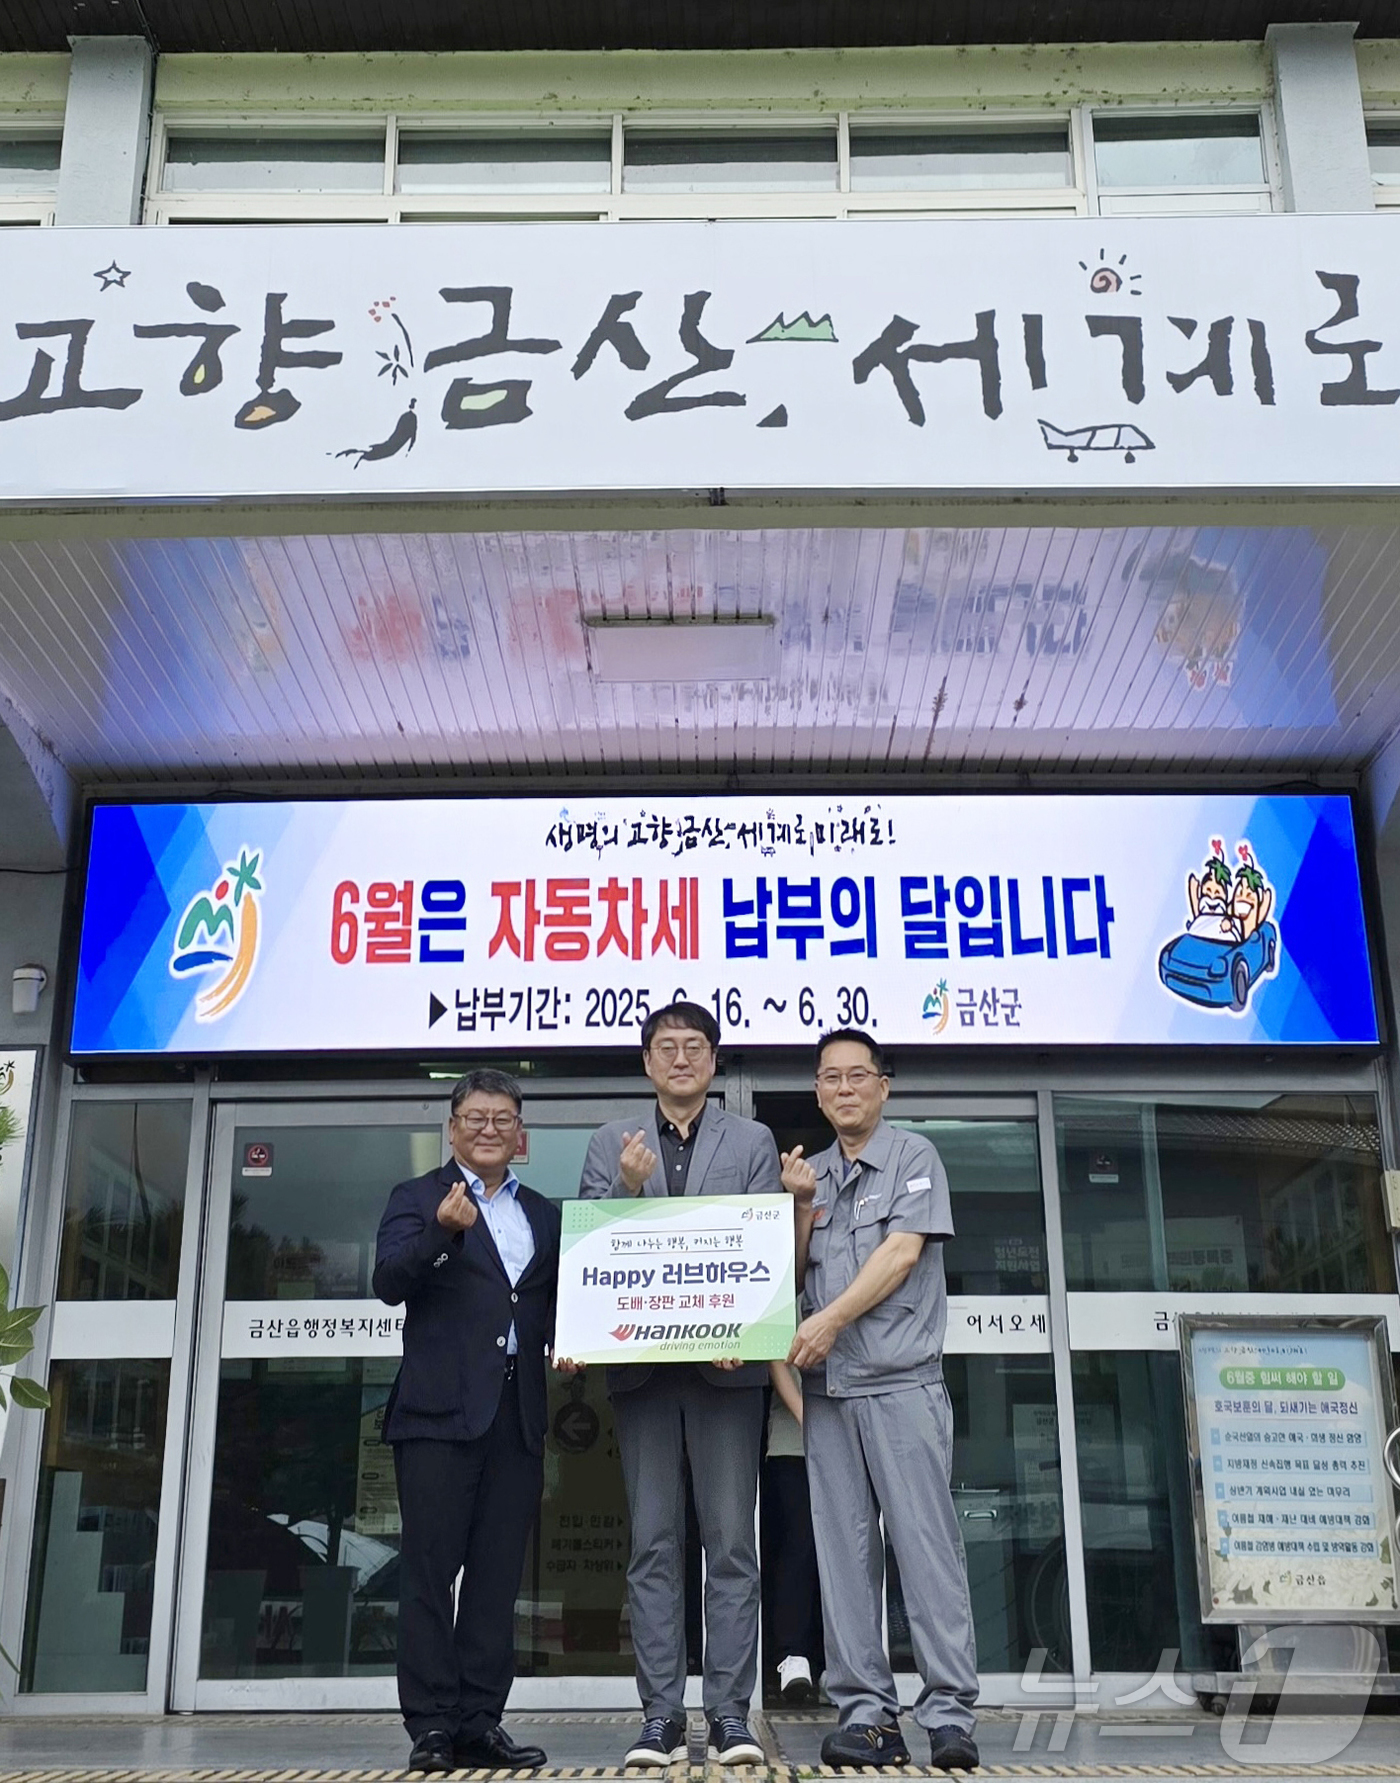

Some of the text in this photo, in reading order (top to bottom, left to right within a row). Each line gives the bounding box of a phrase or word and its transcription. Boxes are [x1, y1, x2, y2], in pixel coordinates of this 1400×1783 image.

[0, 270, 1400, 430] 고향 금산 세계로
[546, 814, 896, 852] 생명의 고향 금산 세계로 미래로!
[330, 874, 1115, 964] 6월은 자동차세 납부의 달입니다
[454, 987, 571, 1031] 납부기간:
[837, 986, 877, 1028] 30.
[955, 987, 1023, 1028] 금산군
[611, 1238, 632, 1251] 함께
[638, 1237, 663, 1249] 나누는
[725, 1234, 743, 1247] 행복
[582, 1261, 771, 1289] Happy 러브하우스
[617, 1293, 735, 1310] 도배·장판 교체 후원
[659, 1340, 741, 1352] driving emotion
[1226, 1371, 1256, 1385] 6월중
